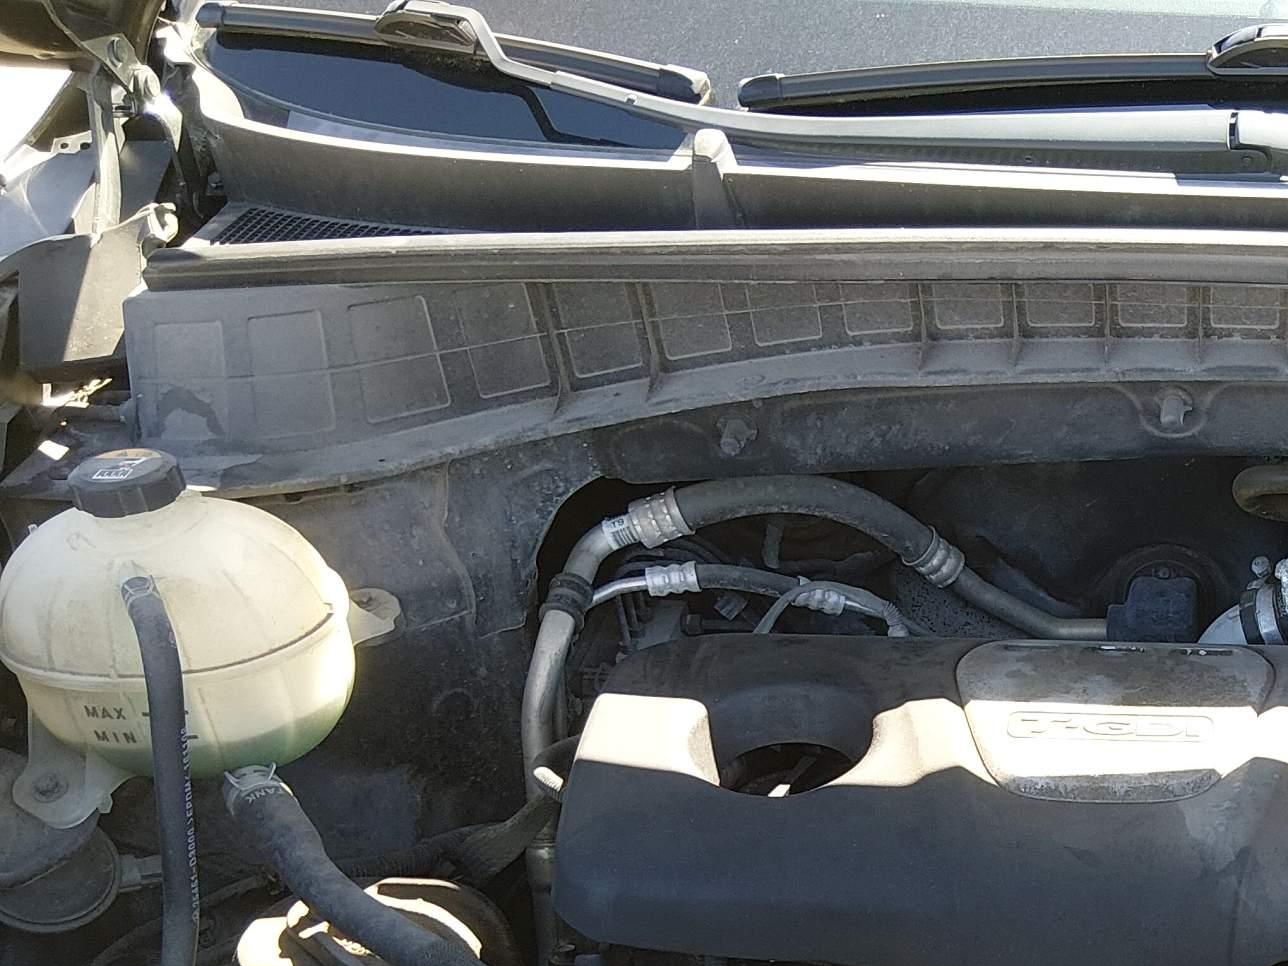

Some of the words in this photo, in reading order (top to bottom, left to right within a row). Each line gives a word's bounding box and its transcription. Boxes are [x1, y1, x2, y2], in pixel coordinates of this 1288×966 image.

[84, 705, 127, 720] MAX
[94, 729, 138, 744] MIN
[246, 787, 283, 804] TANK
